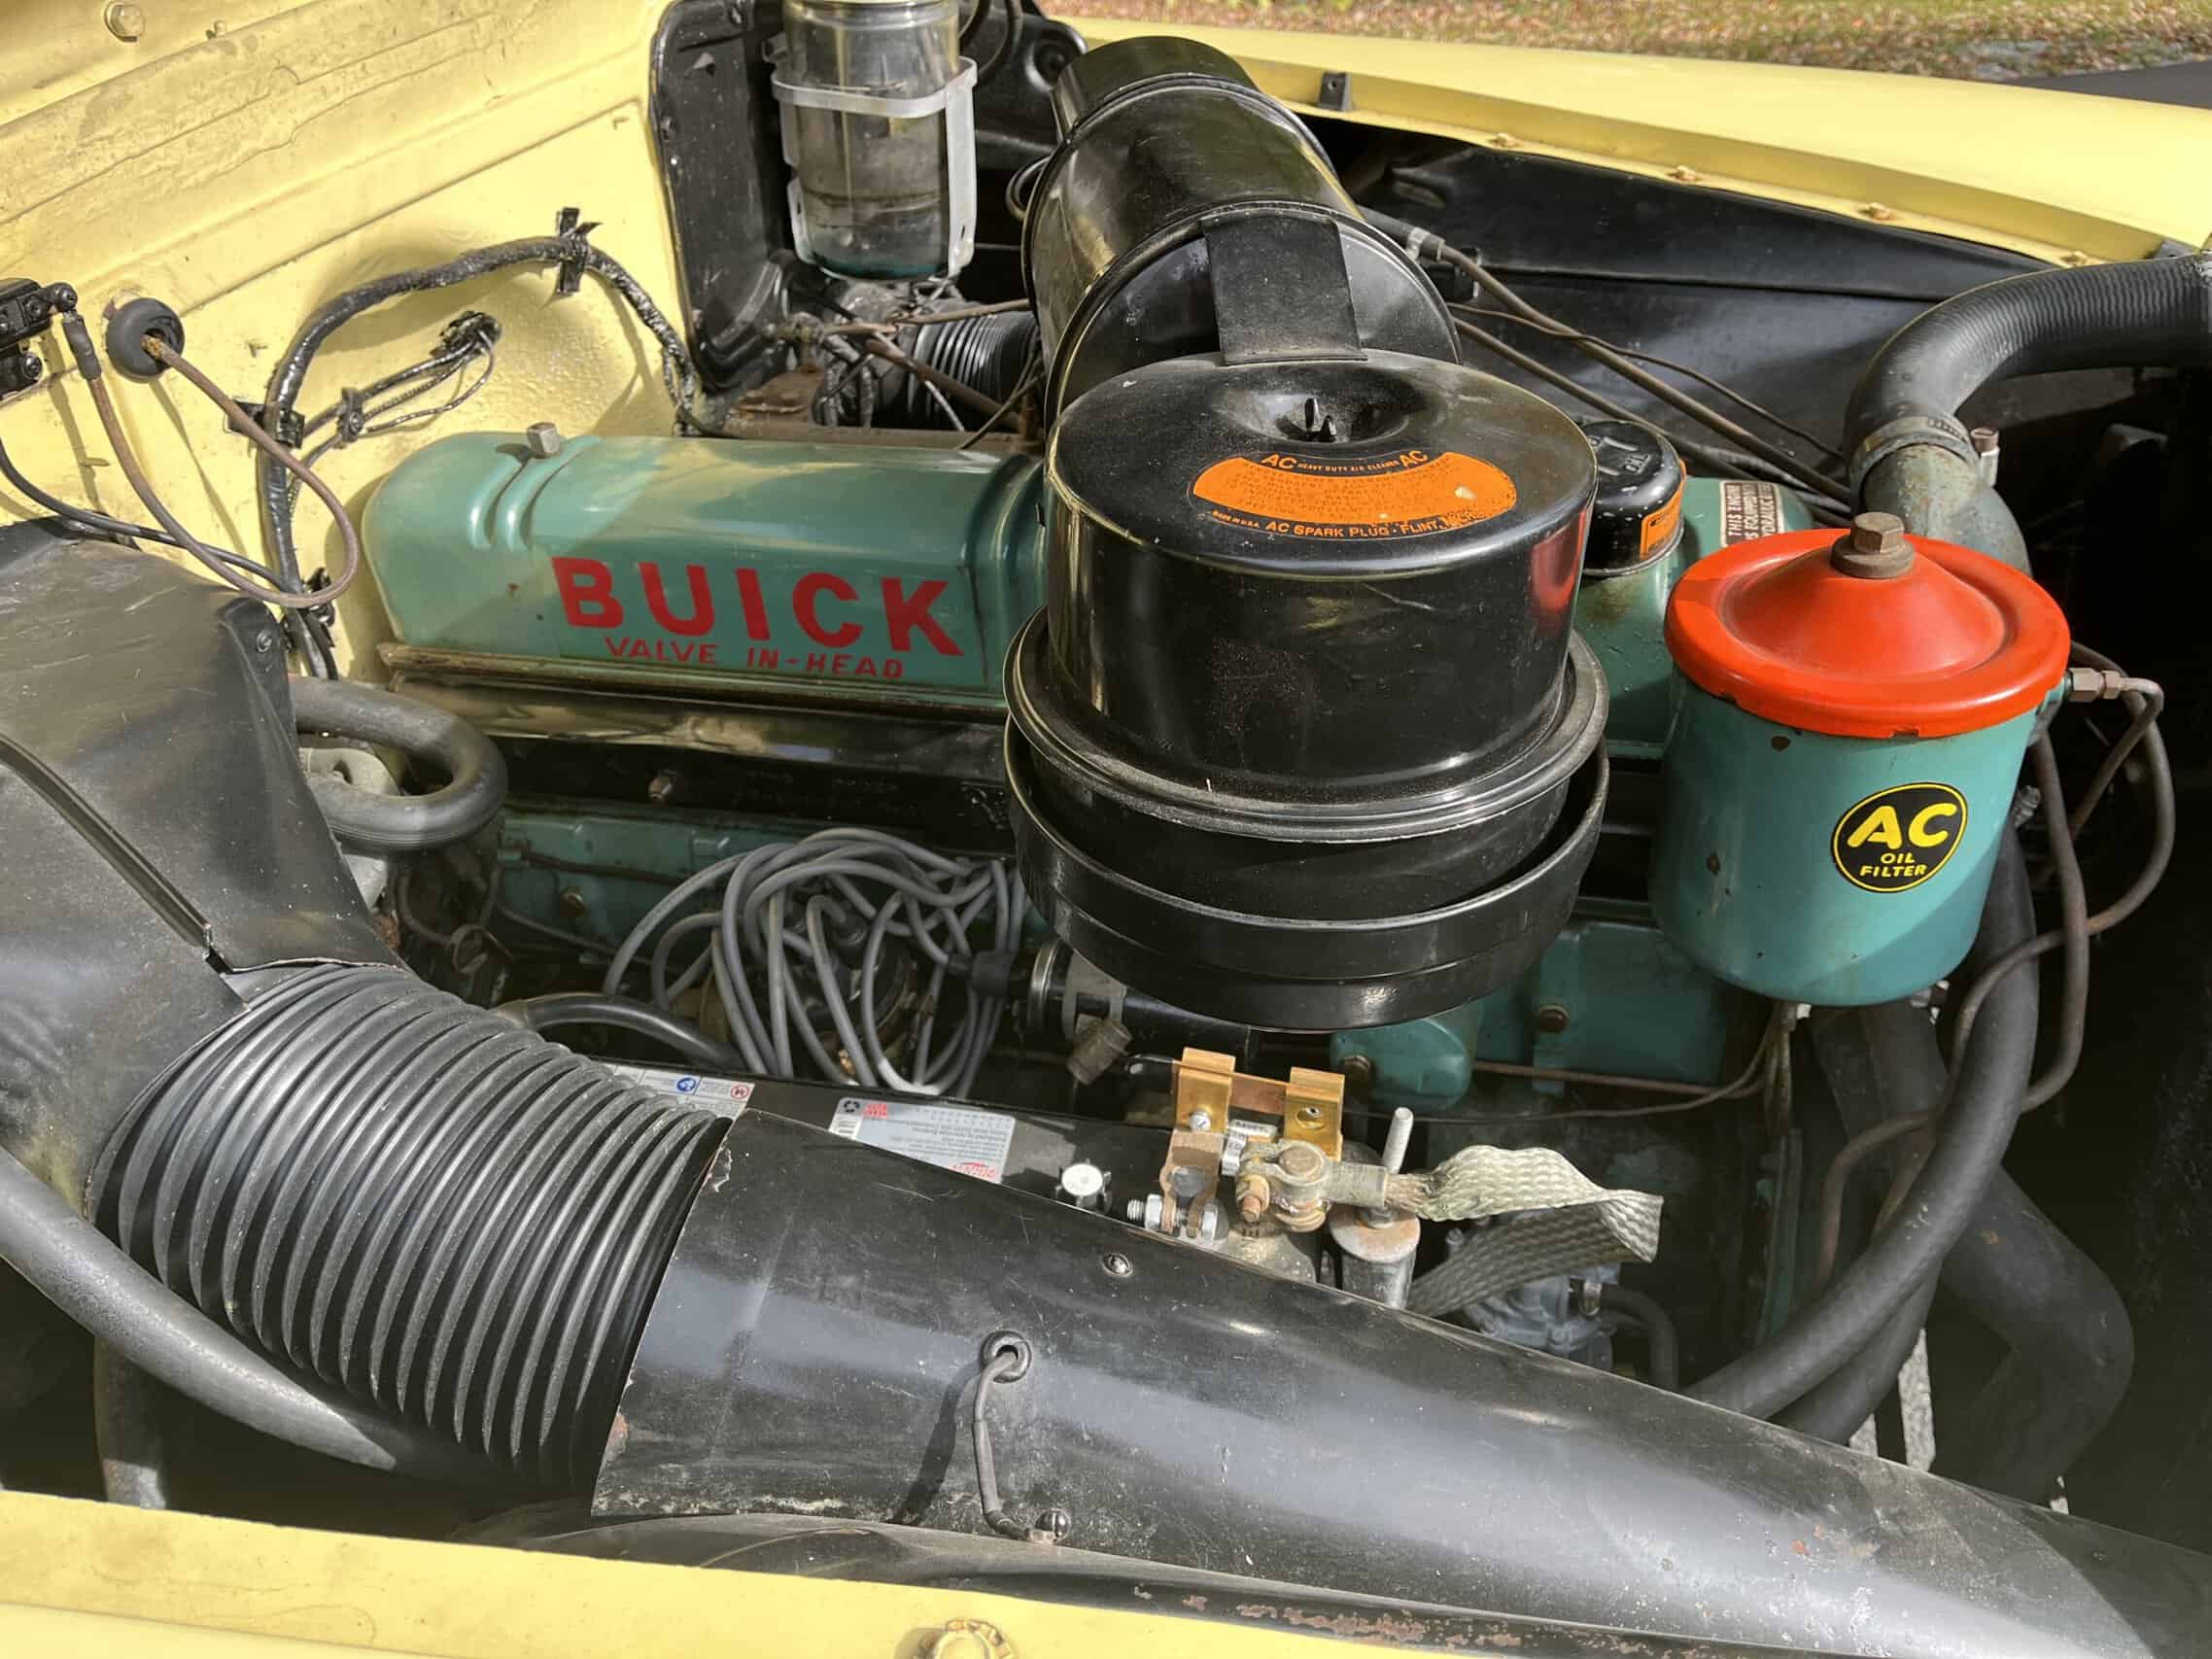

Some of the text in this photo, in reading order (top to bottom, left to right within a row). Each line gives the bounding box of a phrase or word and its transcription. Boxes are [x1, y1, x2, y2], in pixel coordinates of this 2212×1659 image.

[1261, 454, 1297, 469] AC
[1400, 450, 1429, 467] AC
[1265, 520, 1291, 534] AC
[1294, 524, 1344, 537] SPARK
[1349, 524, 1390, 537] PLUG
[1727, 514, 1743, 537] THIS
[551, 557, 964, 656] BUICK
[604, 637, 904, 679] VALVE IN-HEAD
[1847, 802, 1957, 850] AC
[1881, 851, 1916, 864] OIL
[1859, 864, 1928, 878] FILTER
